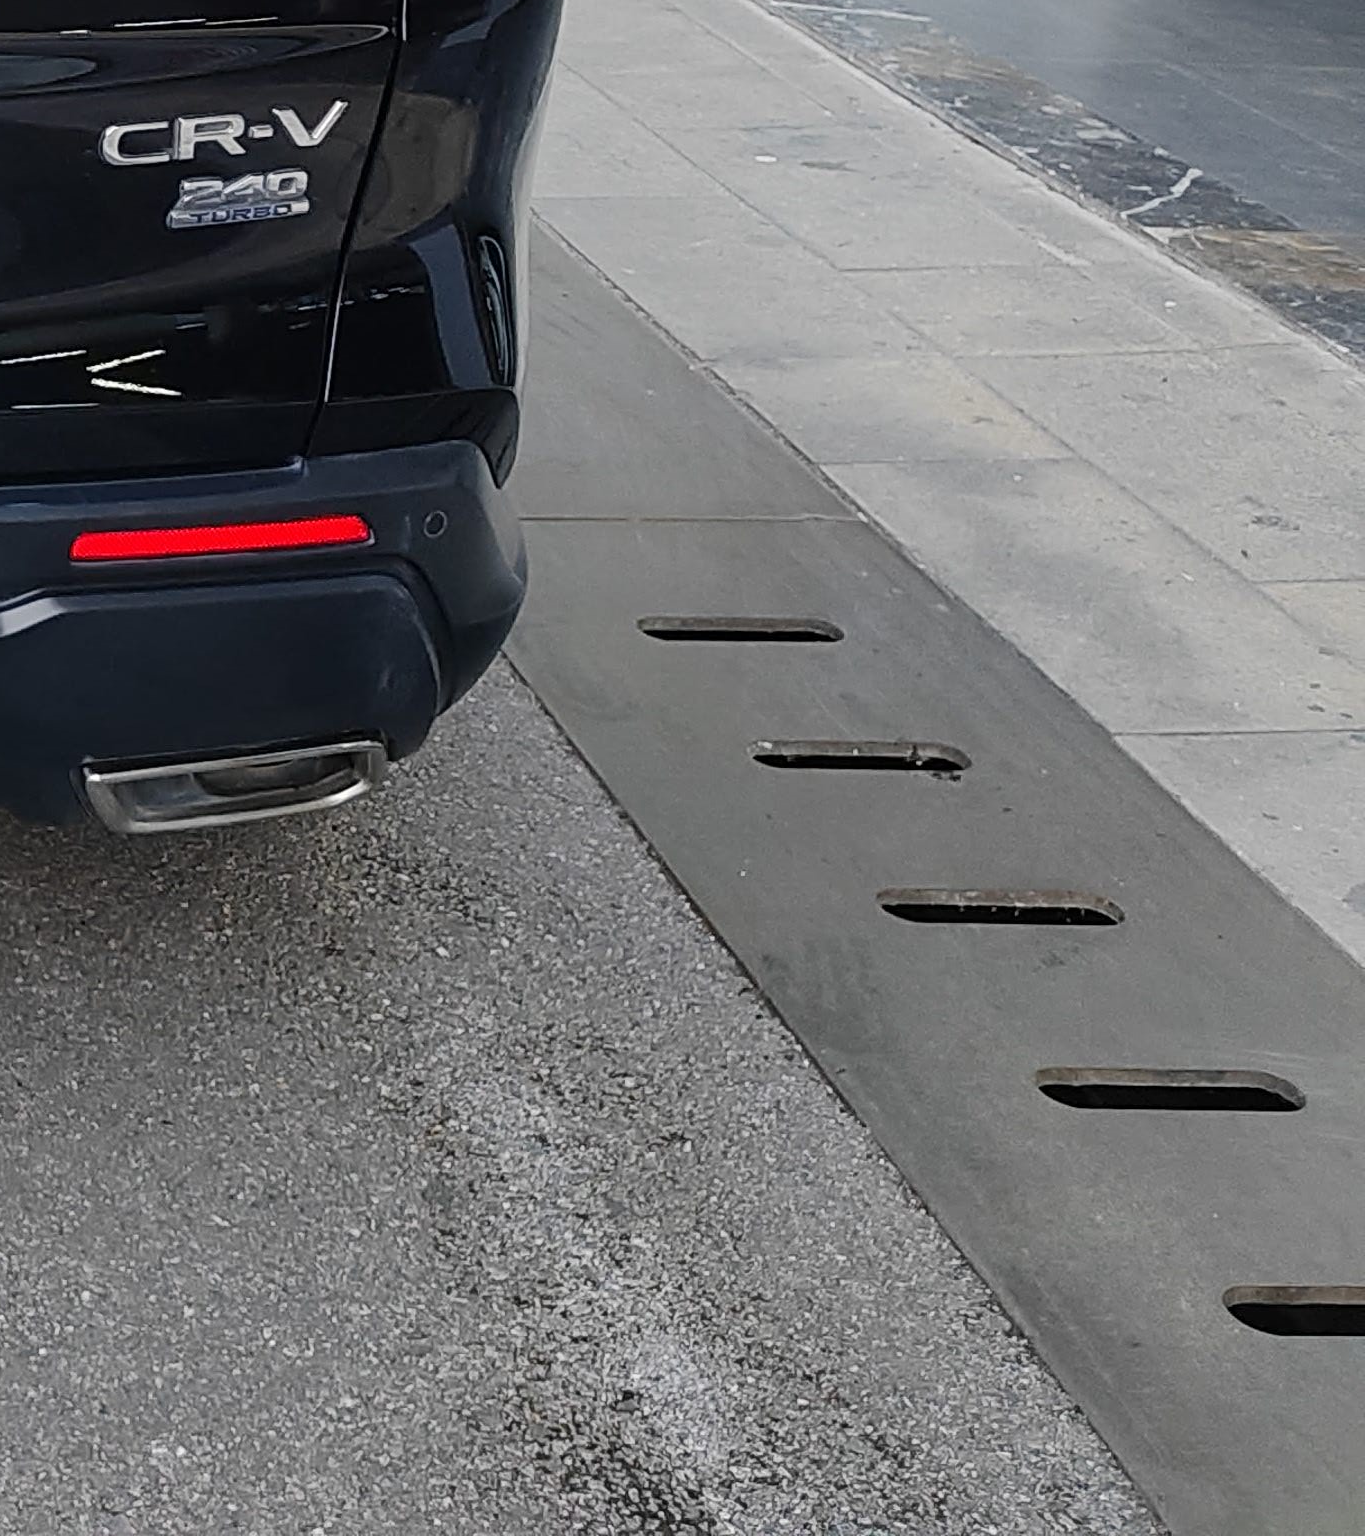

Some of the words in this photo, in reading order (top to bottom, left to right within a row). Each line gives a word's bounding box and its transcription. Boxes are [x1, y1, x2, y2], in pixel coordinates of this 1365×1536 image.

[98, 99, 349, 166] CR-V
[173, 168, 309, 210] 240
[189, 203, 293, 224] TURBO
